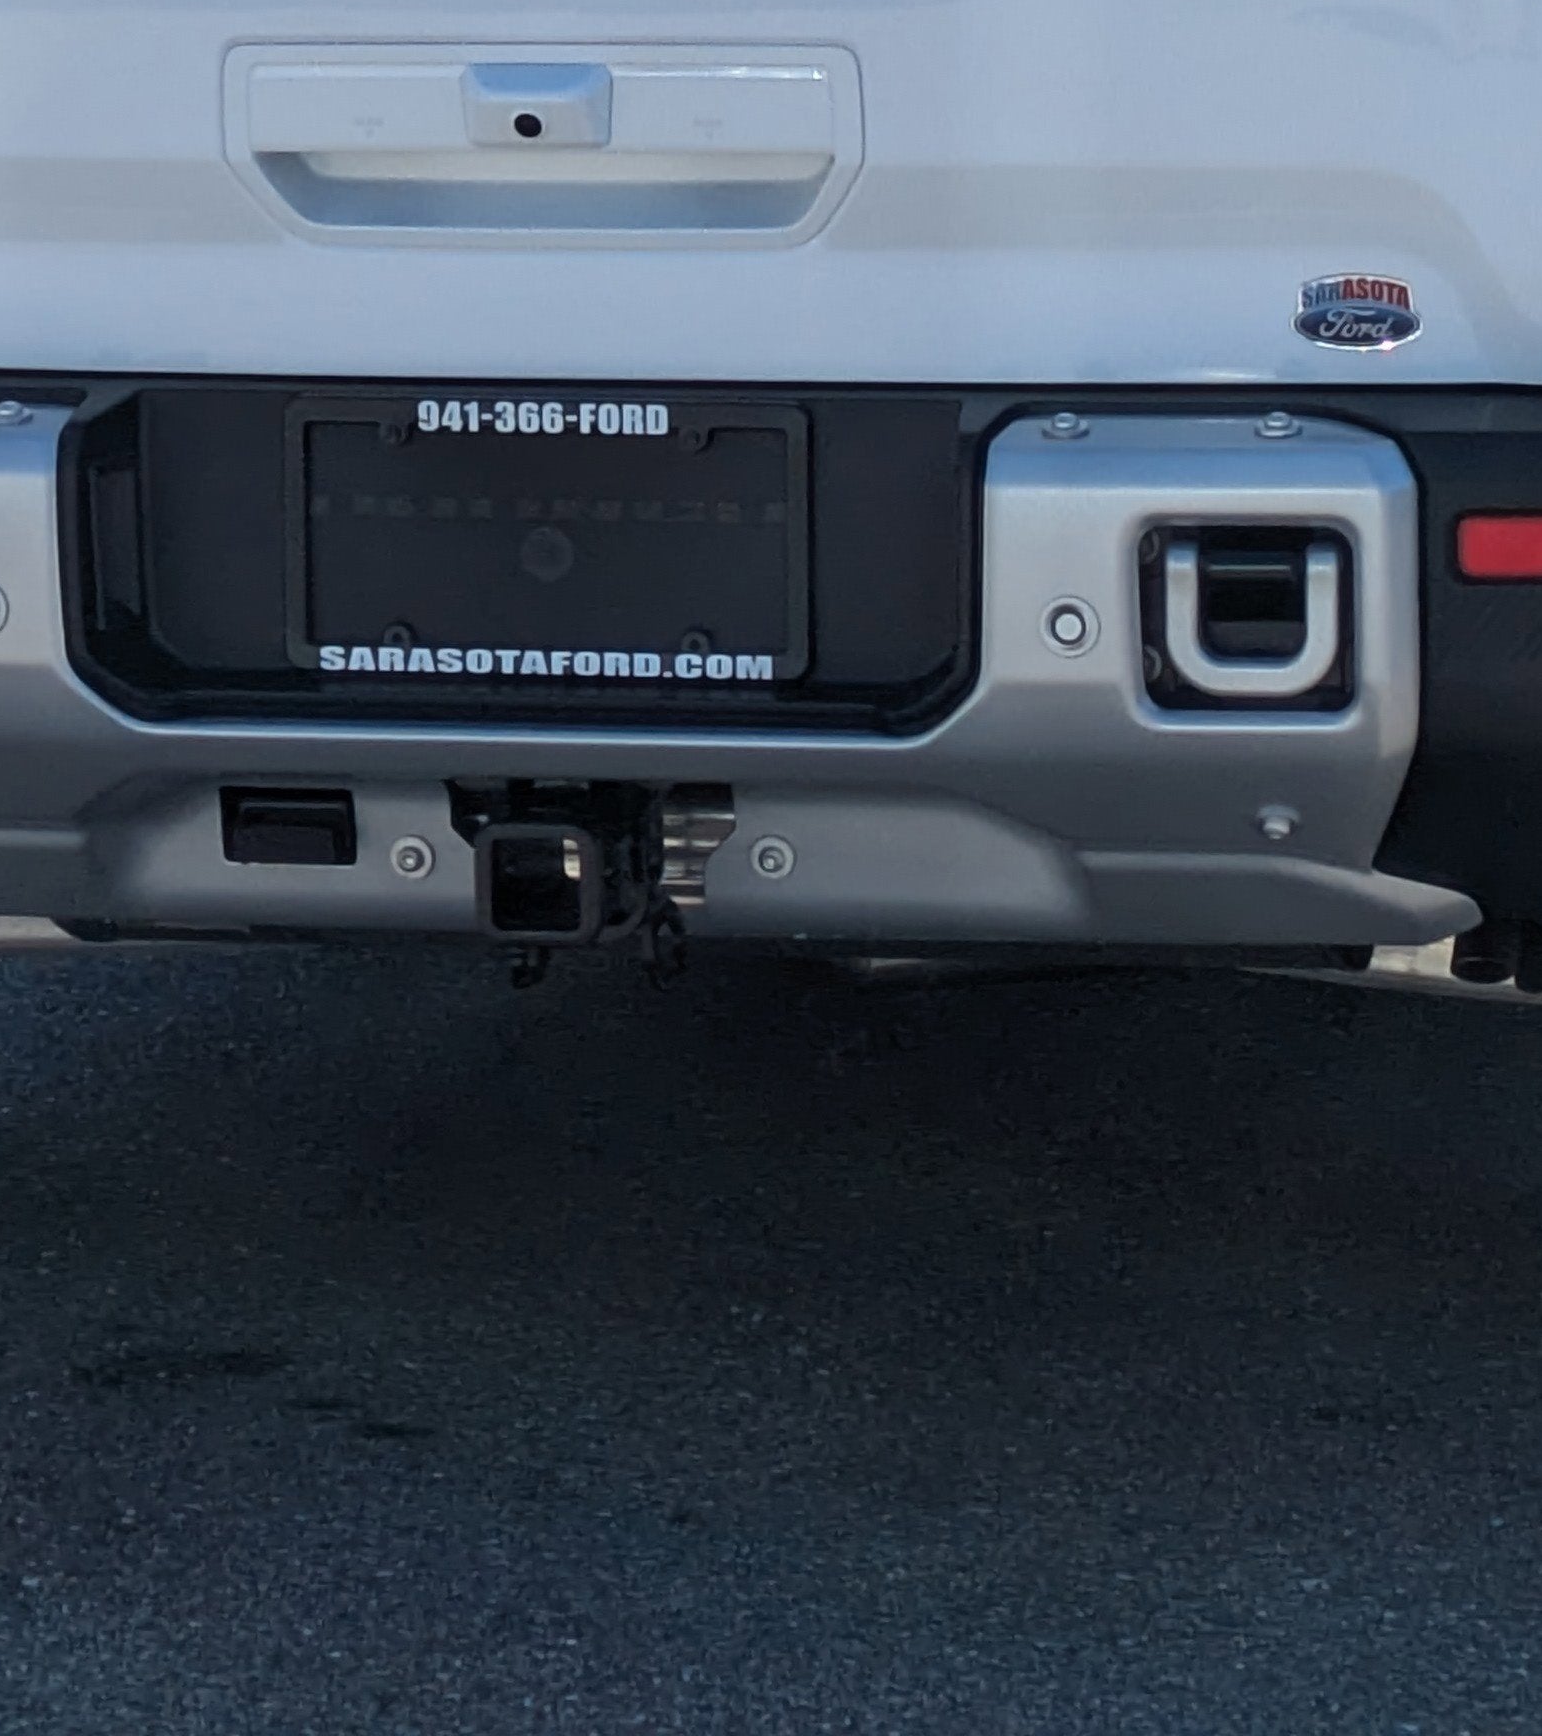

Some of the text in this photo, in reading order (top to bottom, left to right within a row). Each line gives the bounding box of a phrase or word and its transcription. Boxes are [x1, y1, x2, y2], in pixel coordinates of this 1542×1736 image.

[1301, 277, 1411, 310] SARASOTA
[1319, 306, 1394, 339] Ford
[417, 400, 669, 435] 941-366-FORD
[319, 645, 774, 680] SARASOTAFORD.COM
